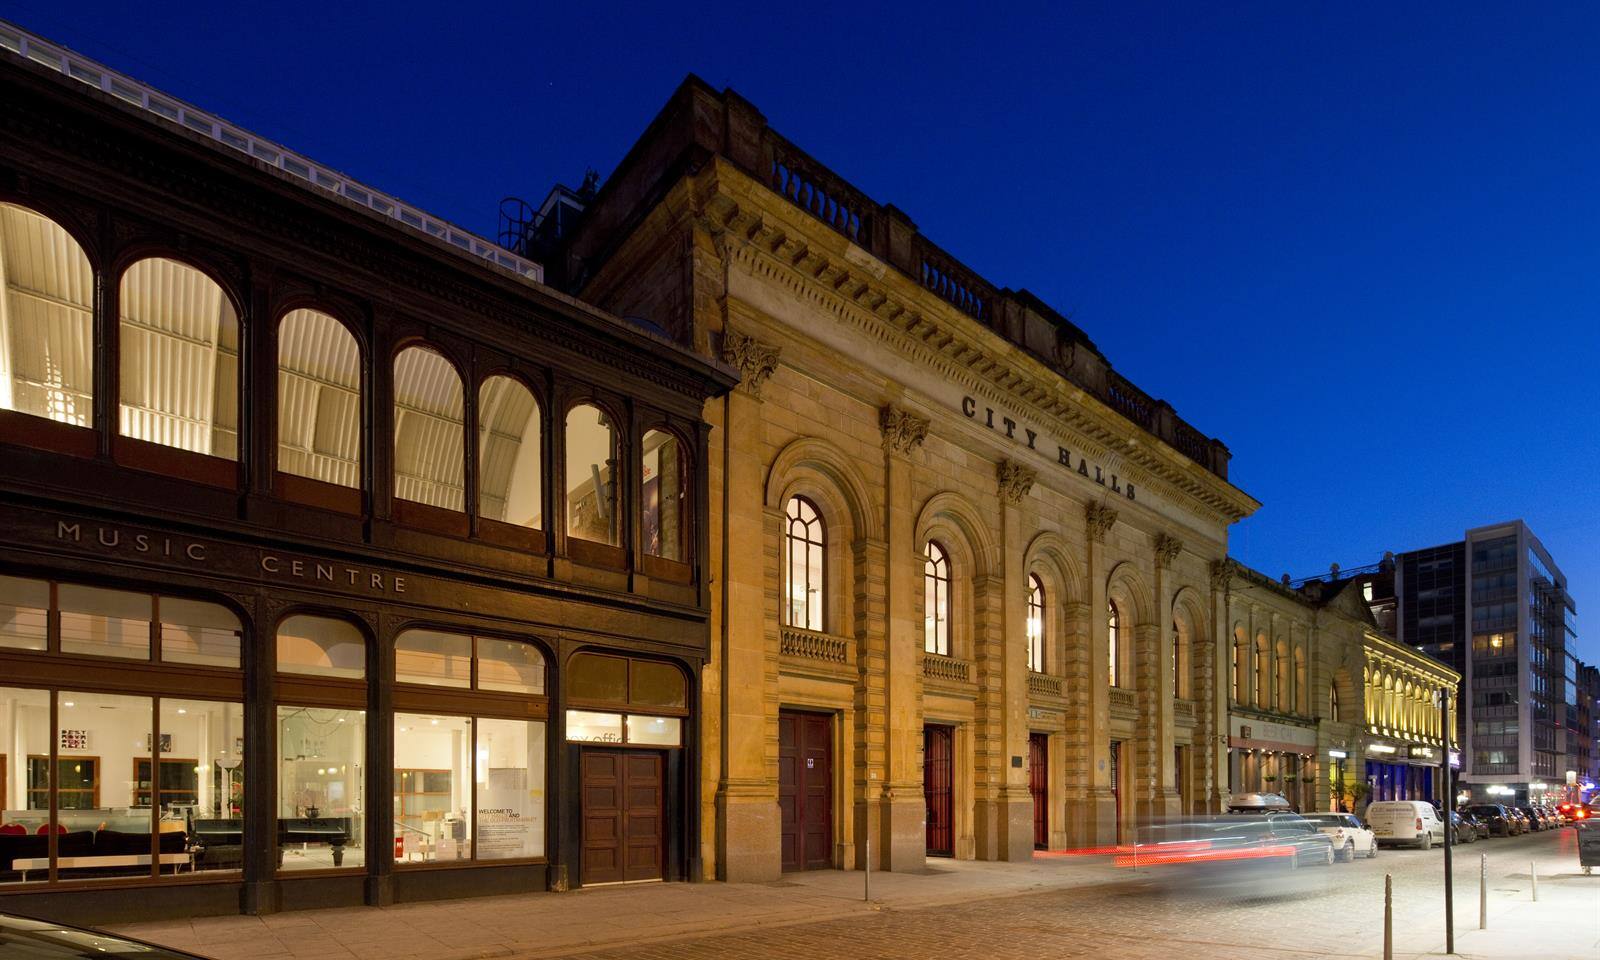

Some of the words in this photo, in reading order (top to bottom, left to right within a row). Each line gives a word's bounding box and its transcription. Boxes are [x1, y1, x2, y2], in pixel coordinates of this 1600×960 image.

[962, 396, 1038, 449] CITY
[1058, 446, 1136, 501] HALLS
[57, 520, 206, 560] MUSIC
[261, 555, 407, 592] CENTRE
